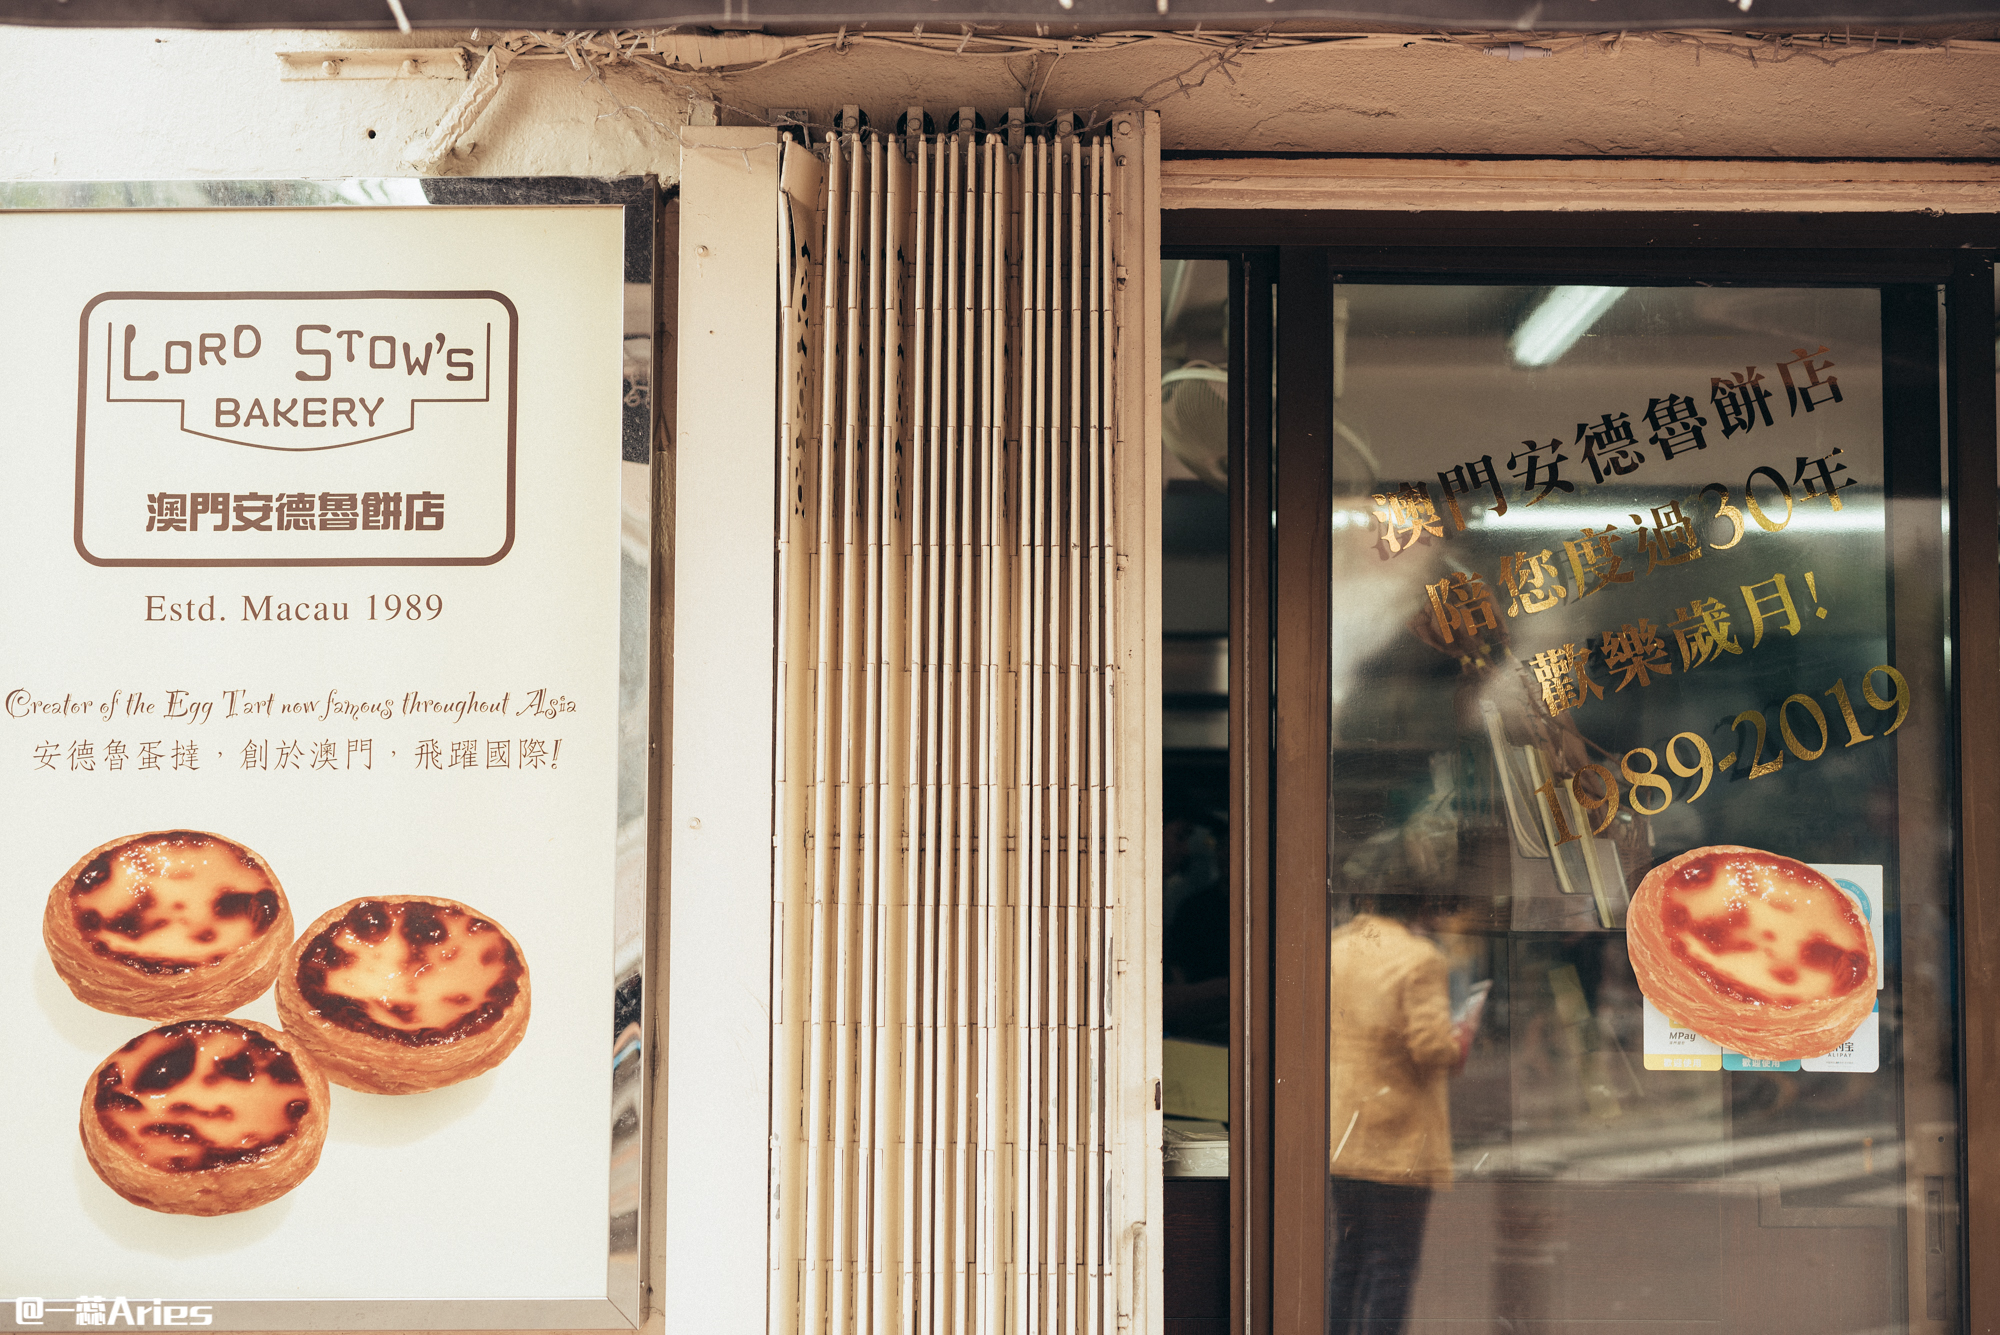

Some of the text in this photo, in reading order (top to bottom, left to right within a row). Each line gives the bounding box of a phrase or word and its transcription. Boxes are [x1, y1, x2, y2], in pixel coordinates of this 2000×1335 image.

[214, 396, 385, 428] BAKERY
[1371, 345, 1844, 554] 澳門安德魯餅店
[145, 491, 446, 533] 澳門安德魯餅店
[1424, 446, 1858, 643] 陪您度過30年
[144, 593, 444, 622] Estd. Macau 1989
[1528, 571, 1828, 718] 歡樂歲月!
[4, 687, 578, 725] Creator of the Egg Tart now famous throughout Asia
[1535, 664, 1911, 848] 1989-2019
[1668, 1031, 1697, 1042] MPay
